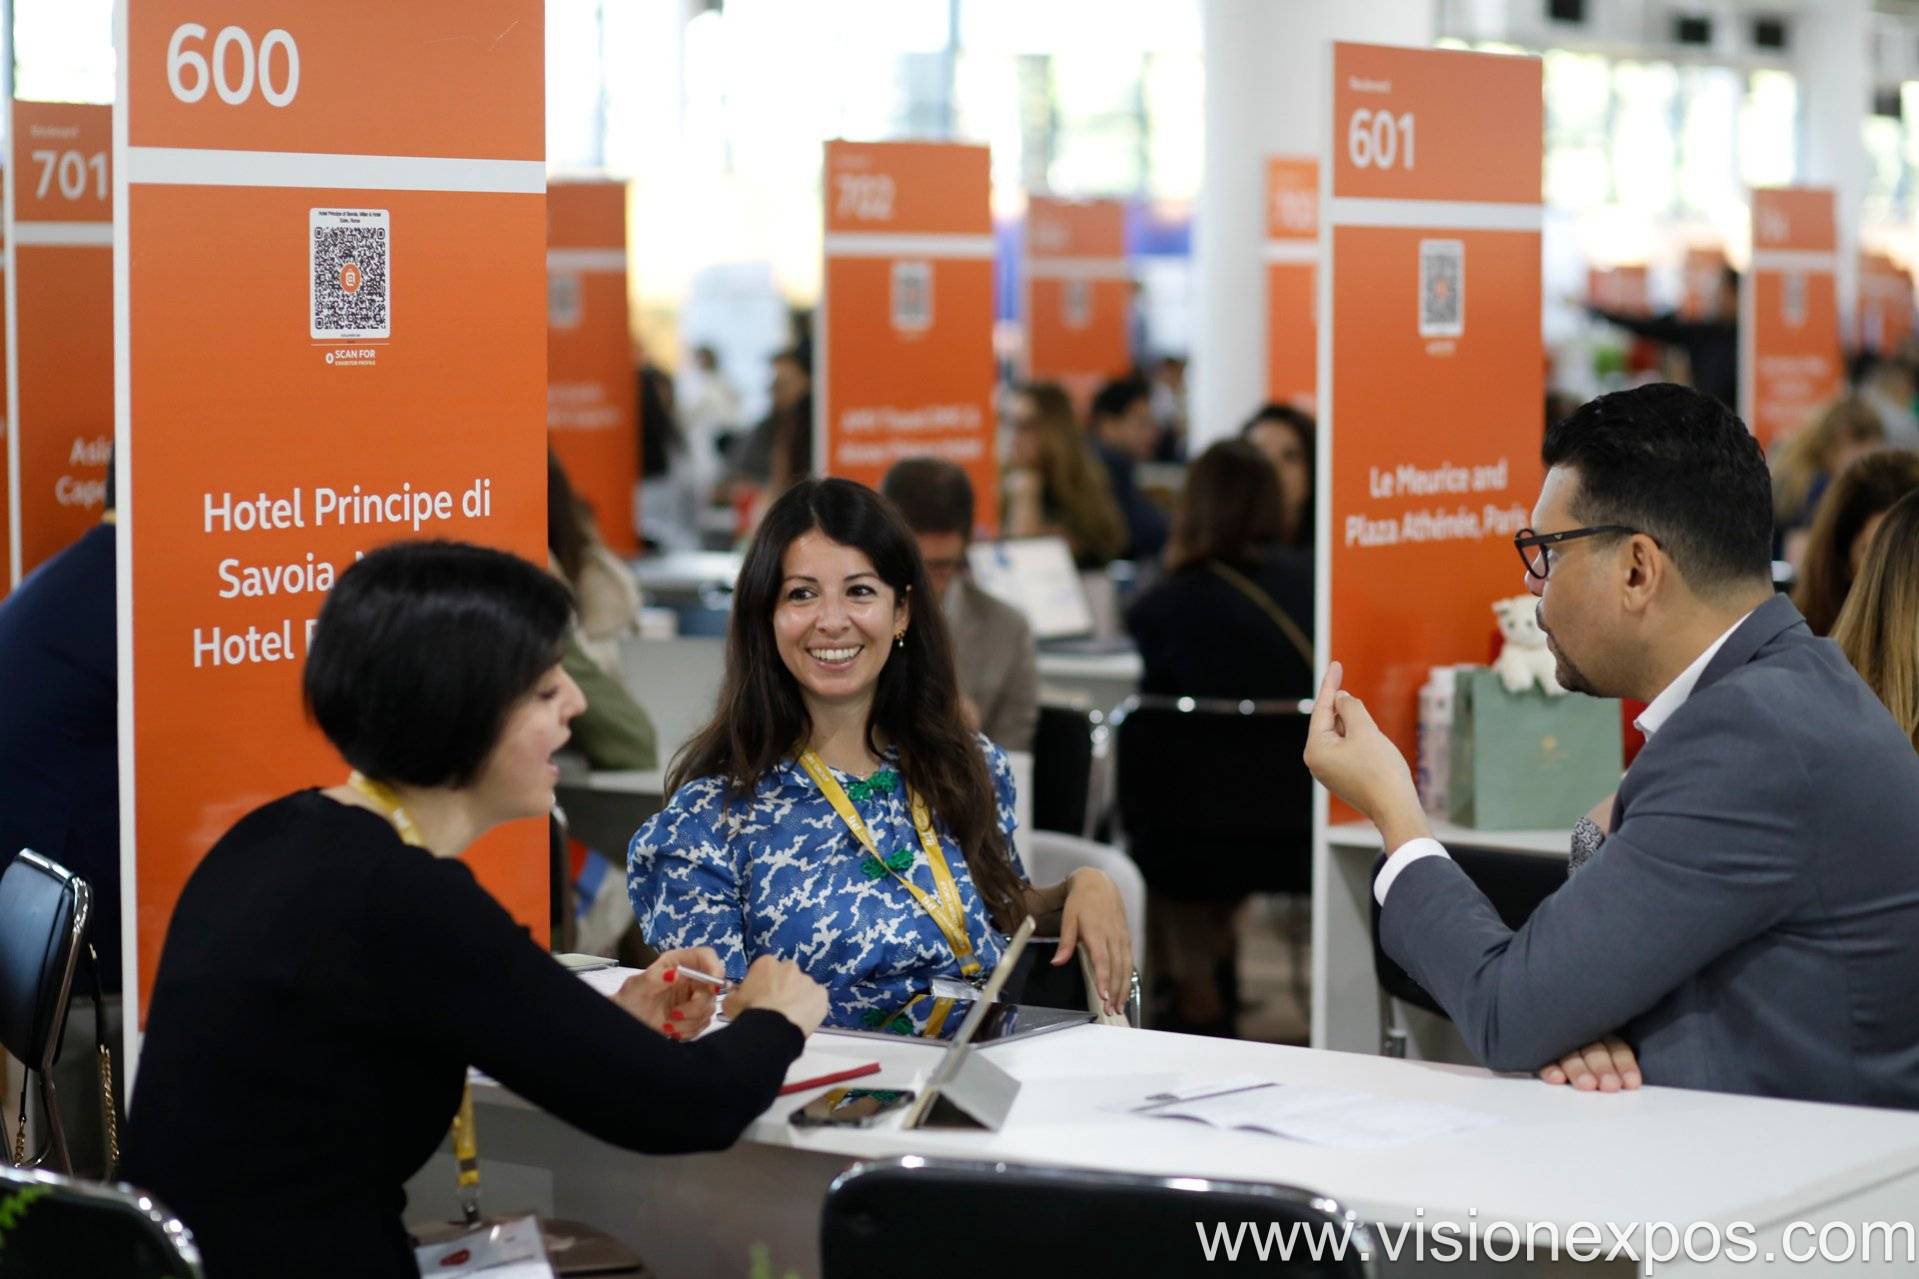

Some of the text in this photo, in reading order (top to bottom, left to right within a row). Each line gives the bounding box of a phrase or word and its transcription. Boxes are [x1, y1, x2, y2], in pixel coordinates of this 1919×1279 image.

[166, 22, 300, 108] 600
[1350, 108, 1415, 169] 601
[31, 151, 107, 200] 701
[335, 349, 376, 359] SCAN FOR
[1370, 466, 1394, 499] Le
[1472, 457, 1508, 491] and
[204, 478, 491, 533] Hotel Principe di
[218, 552, 336, 599] Savoia
[193, 619, 296, 668] Hotel
